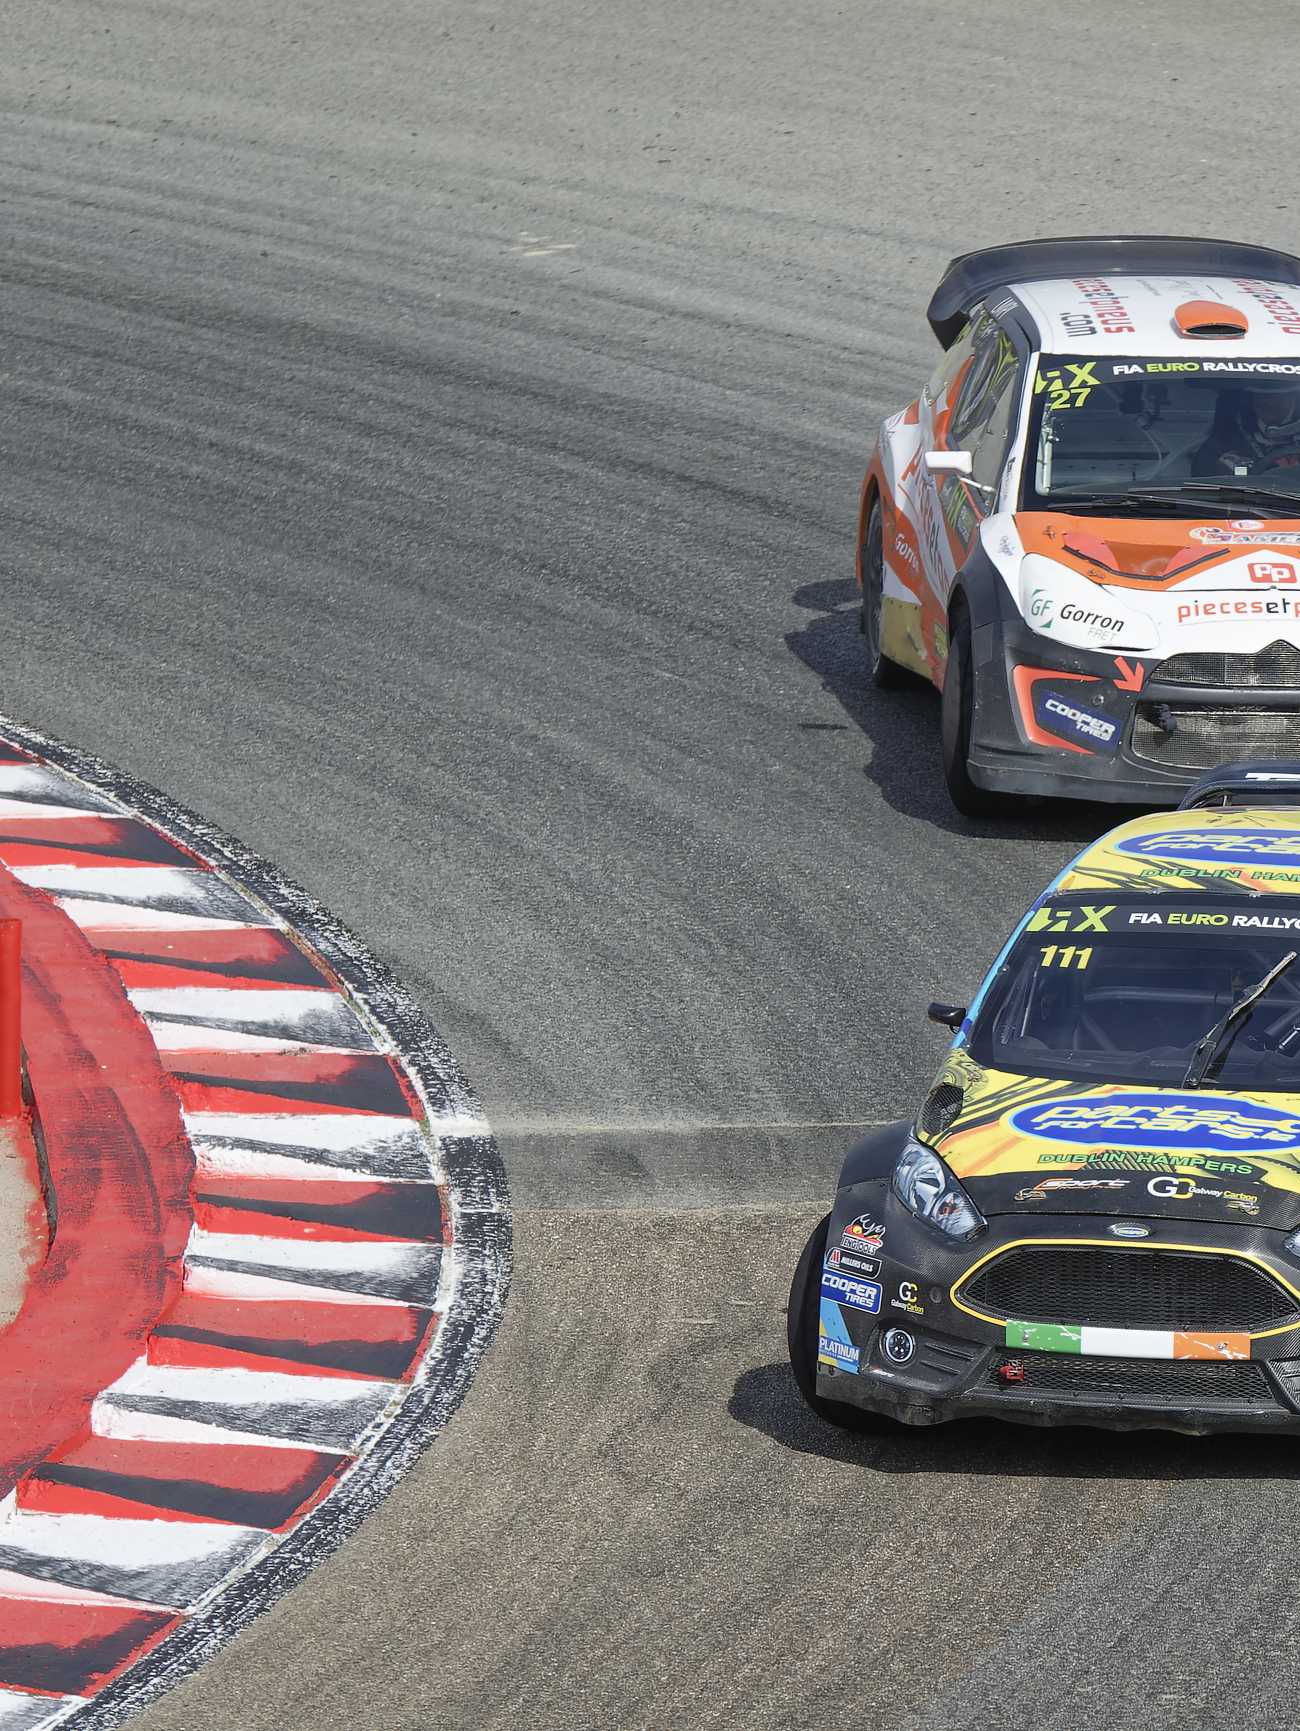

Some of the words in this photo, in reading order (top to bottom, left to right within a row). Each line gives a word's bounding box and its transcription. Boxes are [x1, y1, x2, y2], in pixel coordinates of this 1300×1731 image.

[1113, 364, 1144, 376] FIA
[1147, 362, 1200, 373] EURO
[1050, 388, 1092, 411] 27
[1031, 599, 1053, 616] GF
[1060, 604, 1125, 632] Gorron
[1045, 699, 1116, 734] COOPER
[1140, 868, 1242, 879] DUBLIN
[1128, 913, 1163, 925] FIA
[1167, 913, 1229, 926] EURO
[1040, 945, 1093, 969] 111
[1038, 1152, 1126, 1164] DUBLIN
[1136, 1153, 1254, 1175] HAMPERS
[1188, 1186, 1225, 1197] Galway
[1223, 1190, 1258, 1203] Carbon
[822, 1273, 877, 1299] COOPER
[845, 1292, 874, 1308] TIRES
[820, 1337, 859, 1361] PLATINUM
